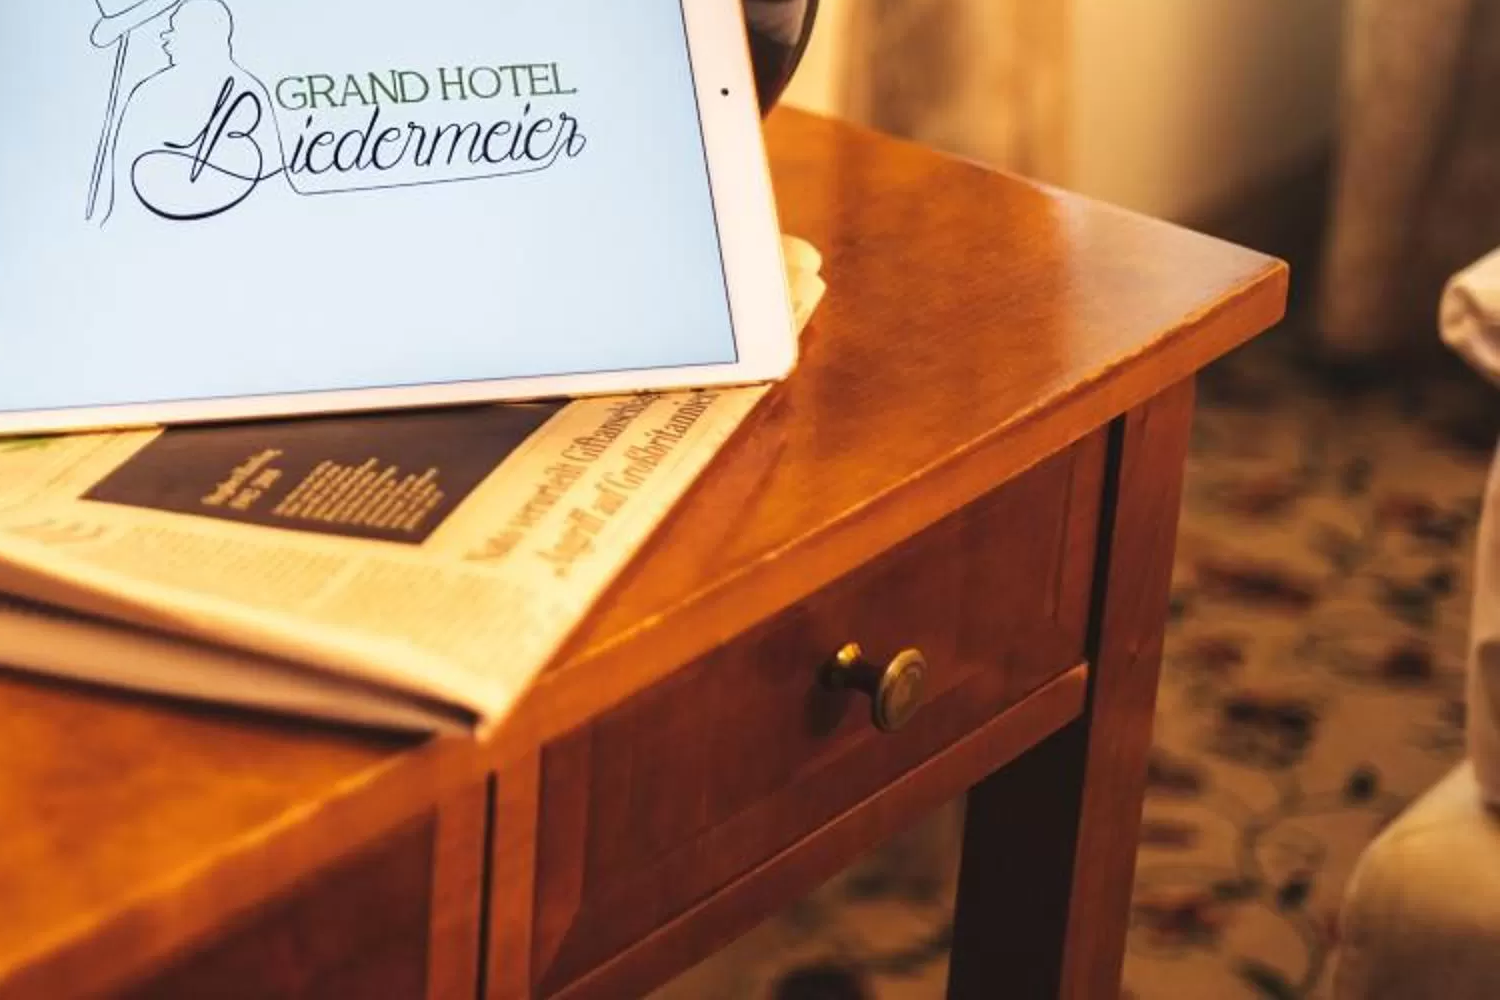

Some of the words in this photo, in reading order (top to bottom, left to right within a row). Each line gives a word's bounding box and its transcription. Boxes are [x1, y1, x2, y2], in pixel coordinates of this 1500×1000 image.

[275, 69, 430, 111] GRAND
[438, 62, 578, 101] HOTEL
[131, 75, 587, 221] Biedermeier
